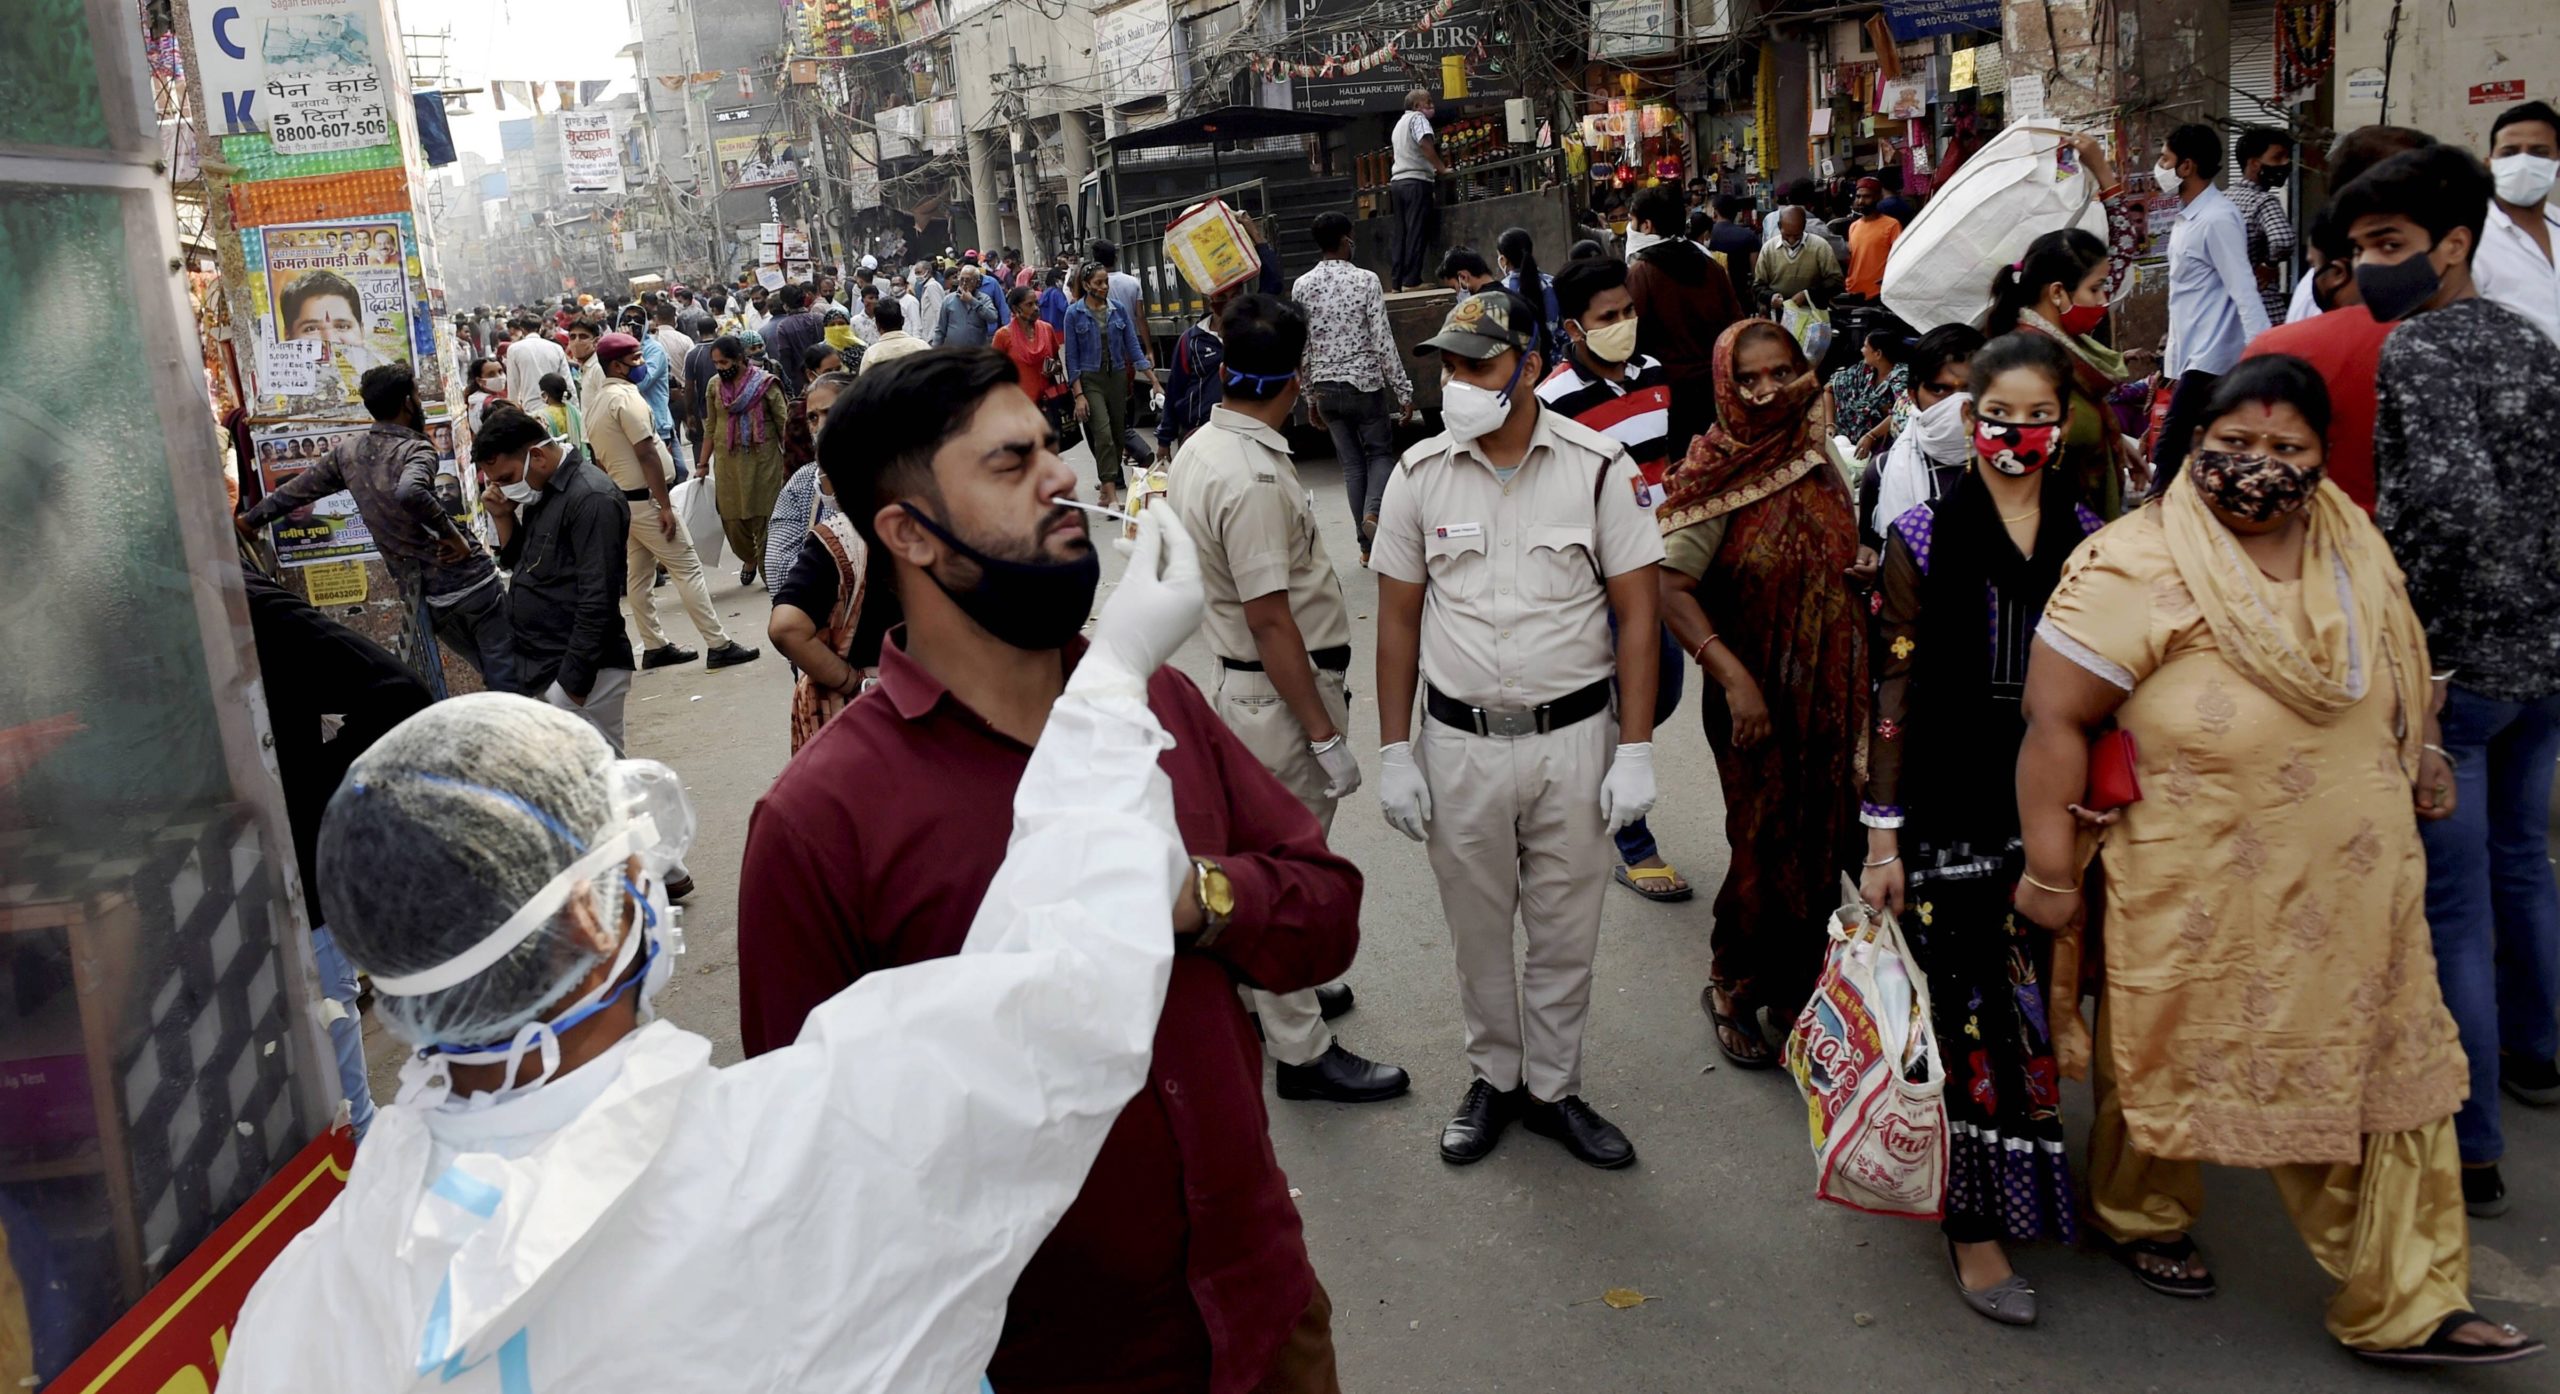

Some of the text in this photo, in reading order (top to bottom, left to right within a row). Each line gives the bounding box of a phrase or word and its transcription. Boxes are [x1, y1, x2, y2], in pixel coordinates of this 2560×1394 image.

[1383, 64, 1403, 73] Sinc
[267, 73, 379, 98] पैन कार्ड
[1339, 86, 1382, 95] HALLMARK
[1311, 99, 1330, 108] Gold
[1330, 97, 1365, 107] Jewellery
[274, 113, 291, 125] 5
[302, 108, 348, 124] दिन
[276, 119, 386, 142] 8800-607-506
[565, 128, 610, 145] मुस्कान
[272, 257, 308, 271] कमल
[352, 253, 369, 267] जी
[370, 278, 400, 293] जन्म
[361, 292, 402, 314] दिवस
[307, 526, 330, 538] गुप्ता
